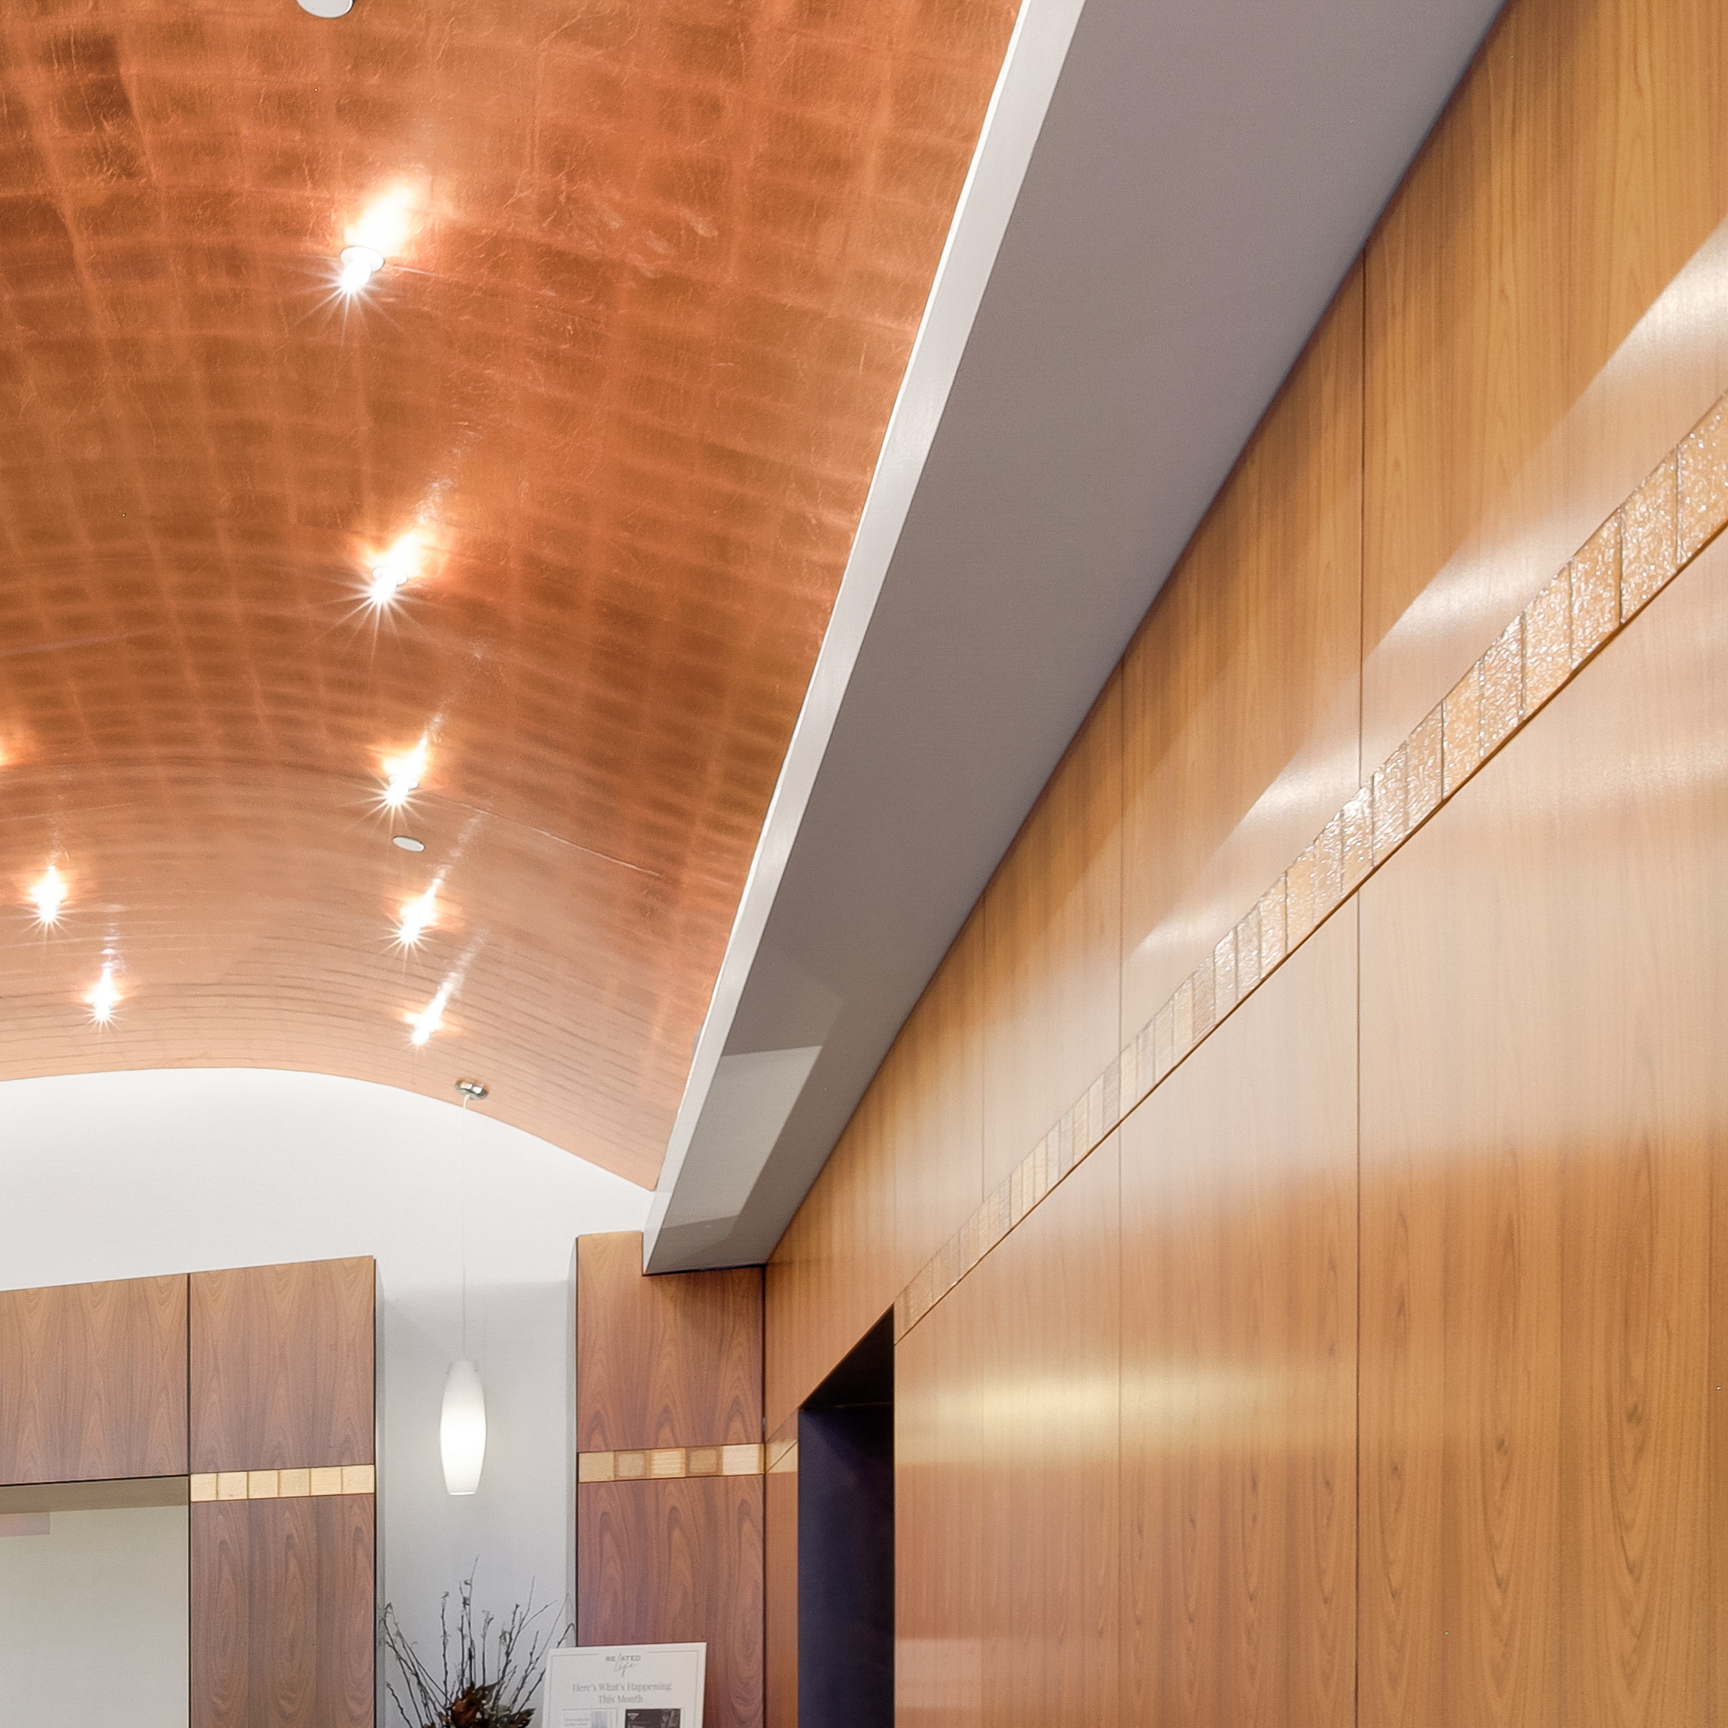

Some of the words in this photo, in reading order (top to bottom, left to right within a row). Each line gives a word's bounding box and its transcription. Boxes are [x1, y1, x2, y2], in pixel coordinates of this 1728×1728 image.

[572, 1683, 597, 1692] Here's
[598, 1682, 624, 1692] What's
[627, 1681, 672, 1693] Happening
[598, 1695, 615, 1703] This
[617, 1694, 643, 1703] Month
